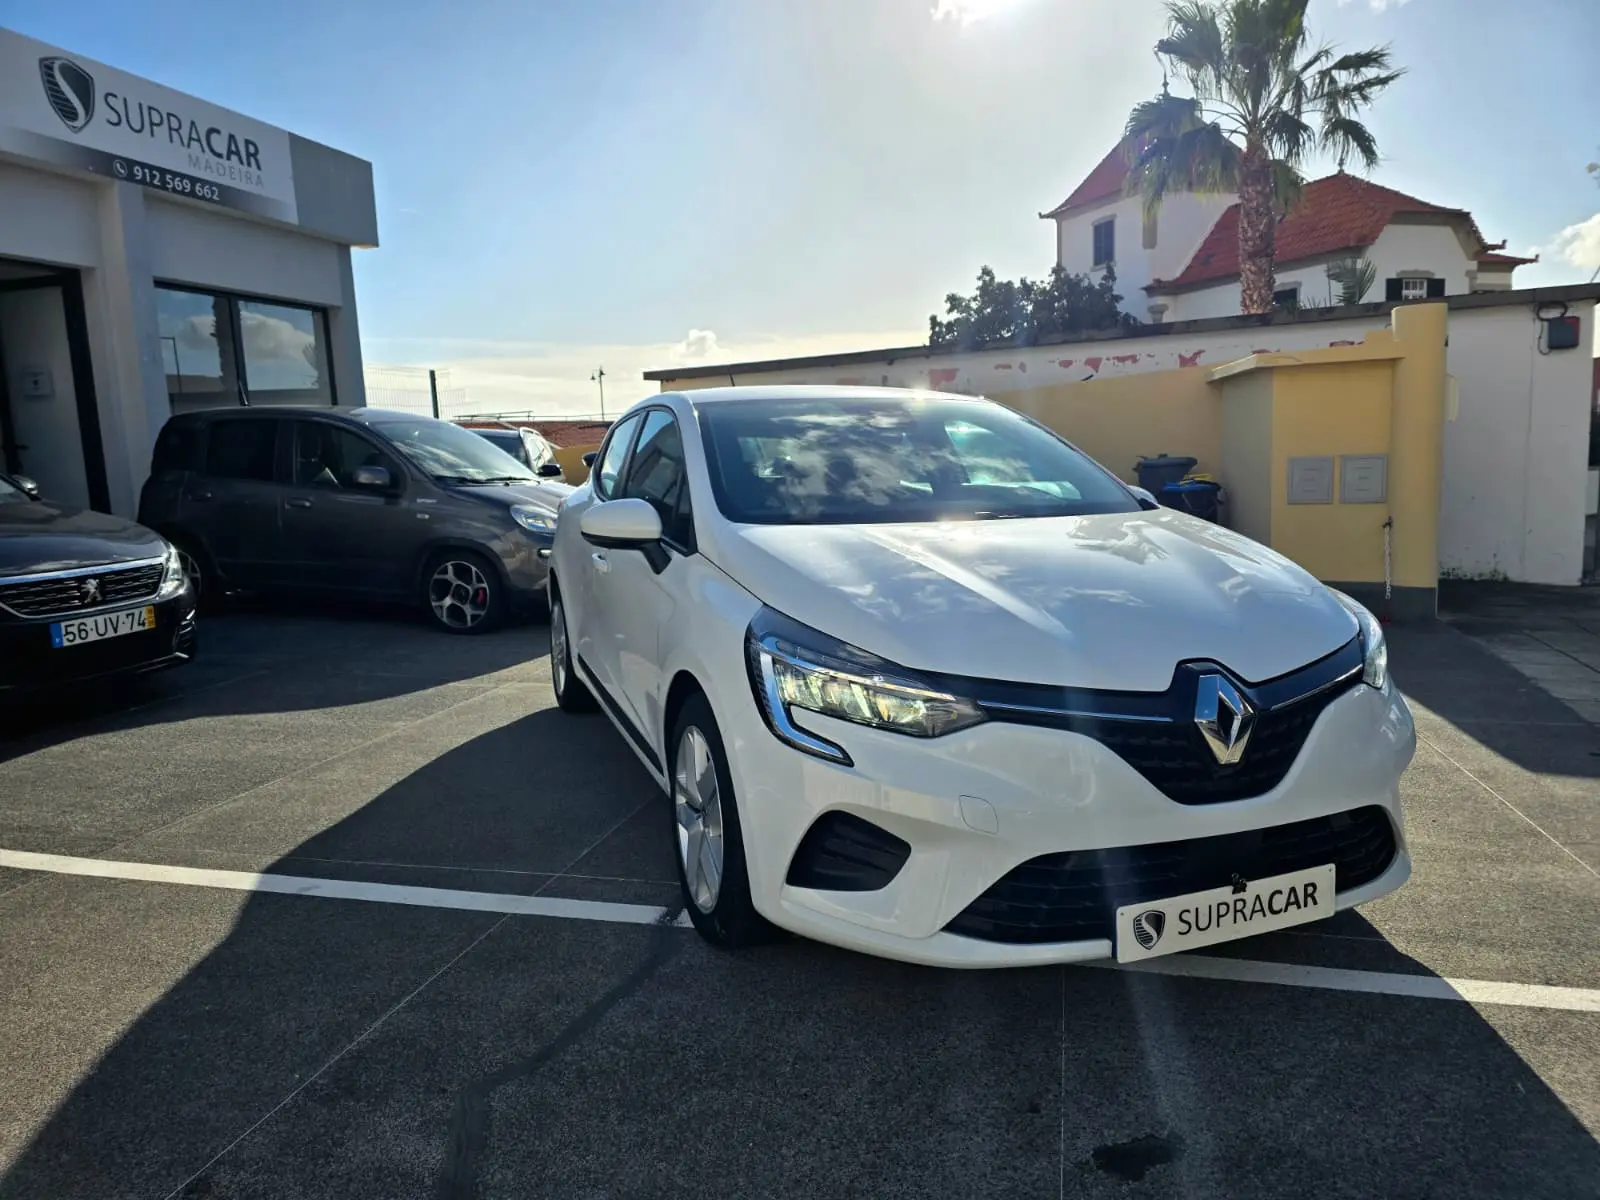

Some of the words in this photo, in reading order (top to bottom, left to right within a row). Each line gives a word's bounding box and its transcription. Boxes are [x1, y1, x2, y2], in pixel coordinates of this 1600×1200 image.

[103, 92, 262, 171] SUPRACAR
[134, 166, 161, 186] 912
[165, 177, 191, 194] 569
[195, 184, 220, 201] 662
[187, 153, 264, 188] MADEIRA
[1178, 882, 1318, 935] SUPRACAR
